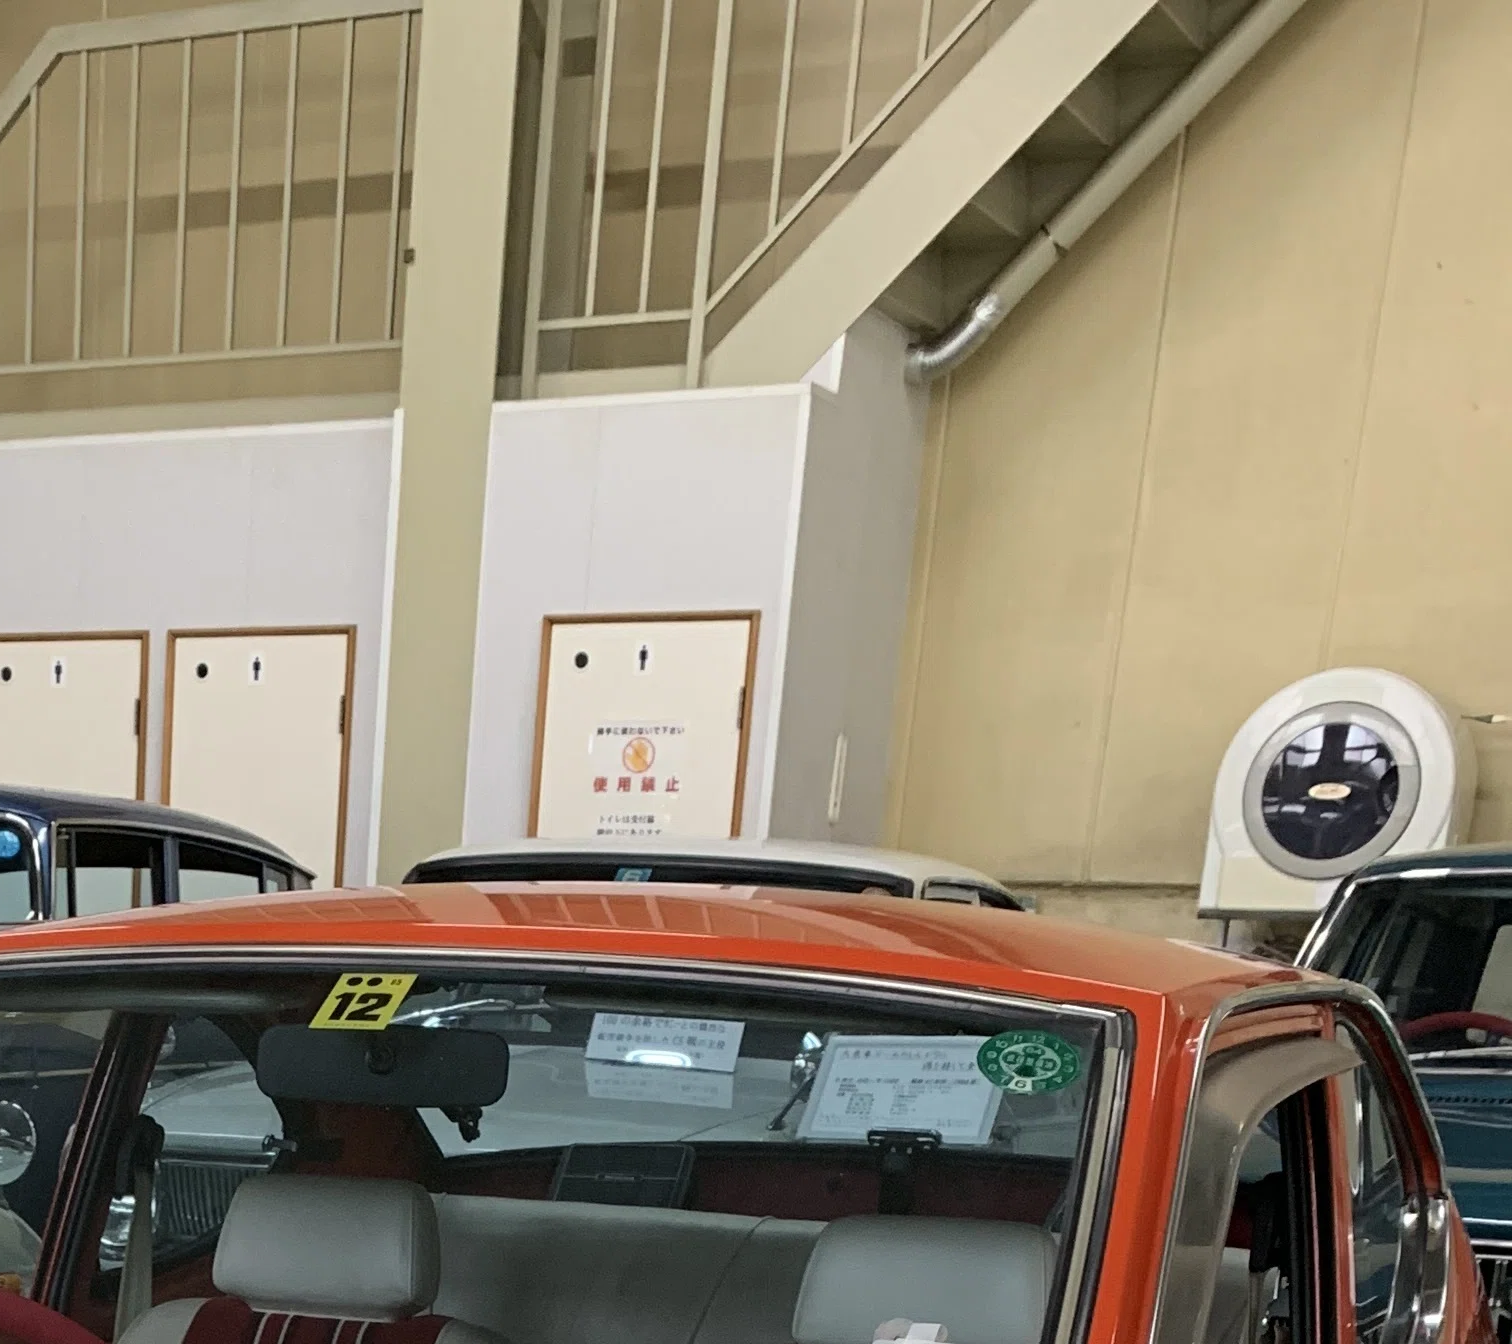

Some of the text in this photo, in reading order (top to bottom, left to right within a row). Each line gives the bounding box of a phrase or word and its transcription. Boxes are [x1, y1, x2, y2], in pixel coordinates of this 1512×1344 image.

[593, 776, 680, 793] 使用禁止
[328, 992, 393, 1022] 12
